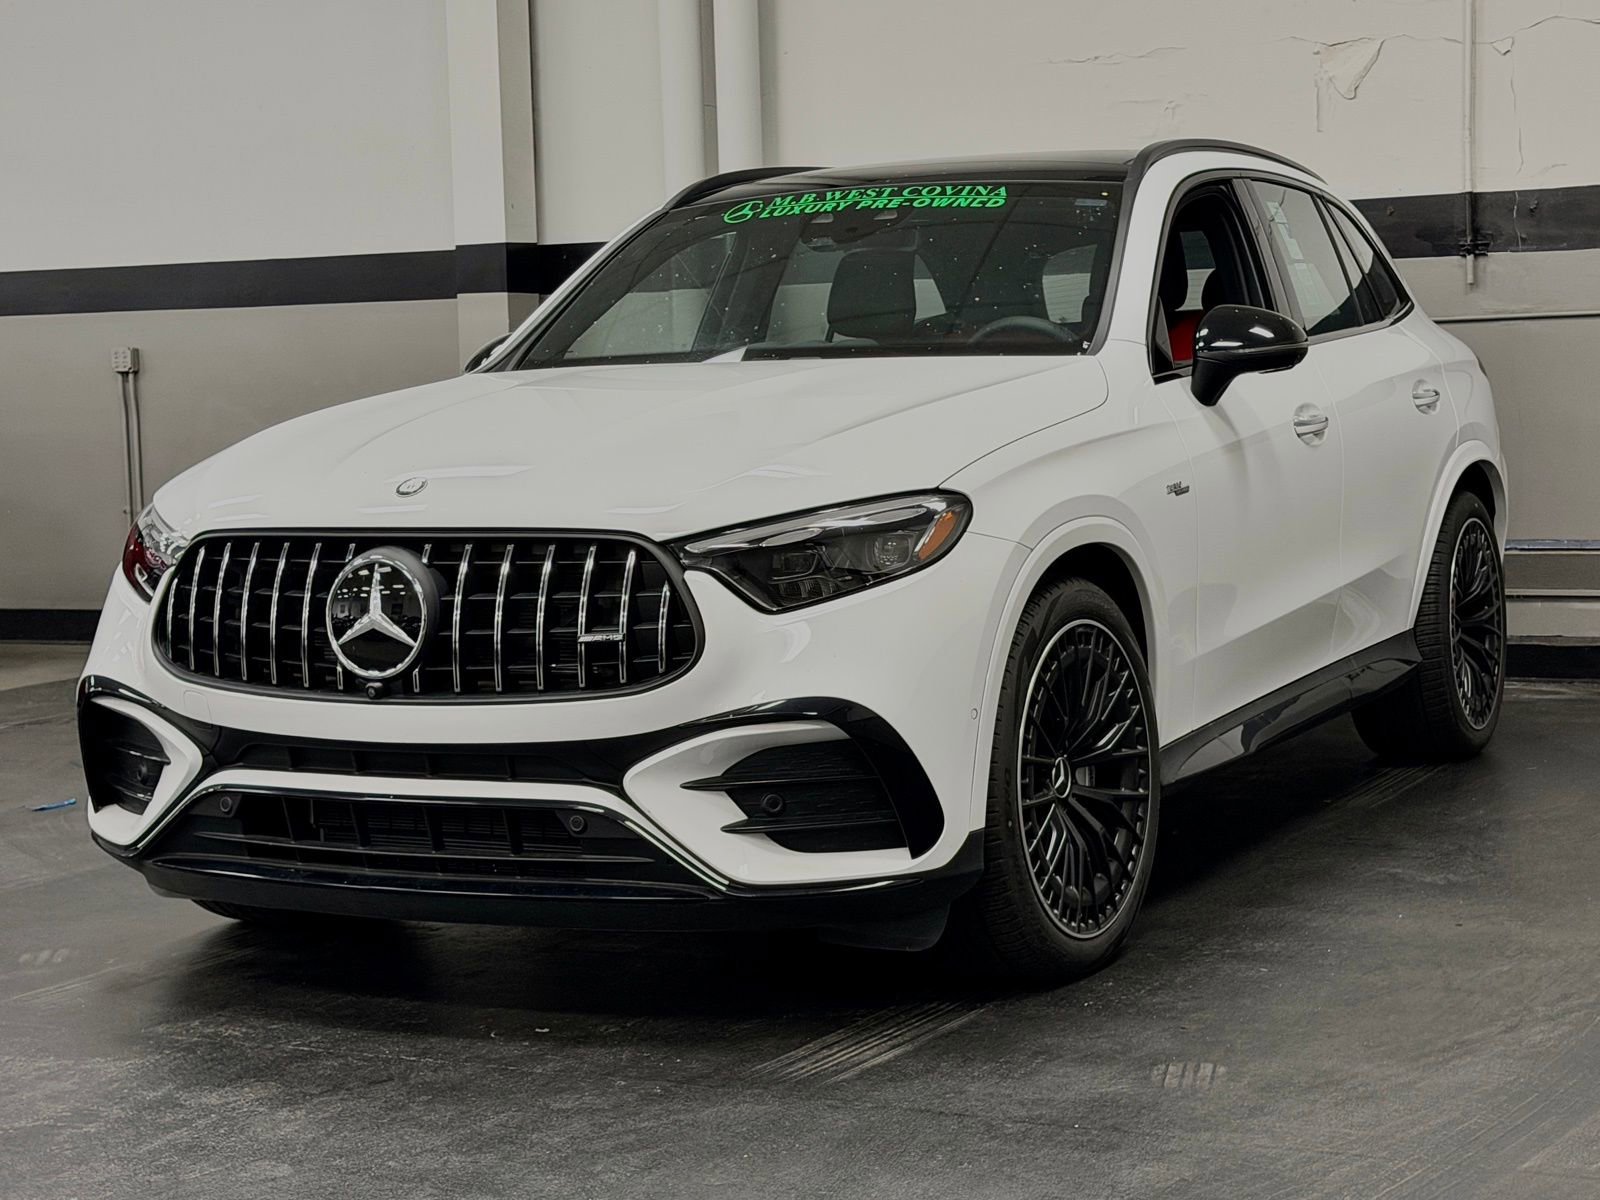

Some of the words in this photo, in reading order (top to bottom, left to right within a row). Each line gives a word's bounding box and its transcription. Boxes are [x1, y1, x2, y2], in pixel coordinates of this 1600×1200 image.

[825, 187, 898, 201] WEST
[902, 185, 1007, 197] COVINA
[759, 202, 853, 218] LUXURY
[856, 197, 1006, 210] PRE-OWNED
